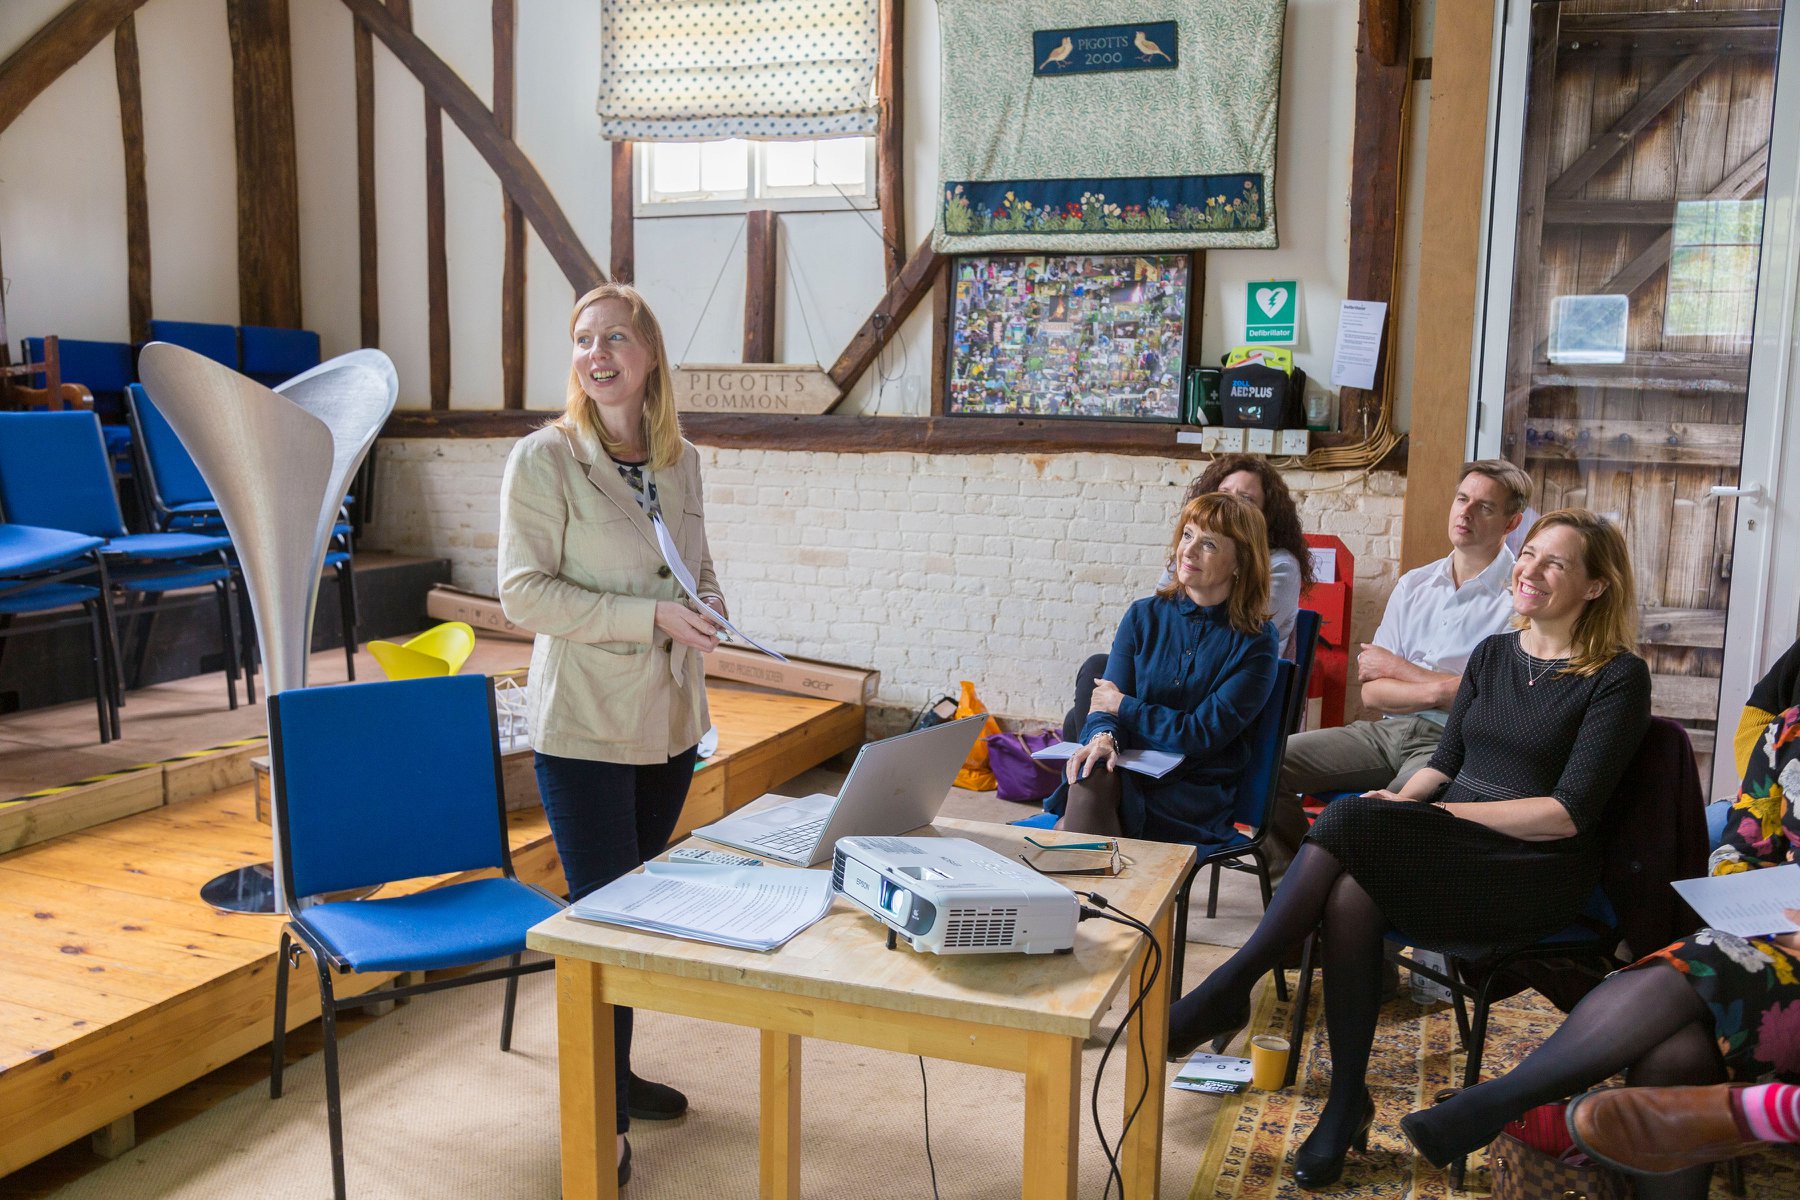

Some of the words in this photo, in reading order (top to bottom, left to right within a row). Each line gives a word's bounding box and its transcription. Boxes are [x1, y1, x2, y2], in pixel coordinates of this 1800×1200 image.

[1078, 35, 1129, 51] PIGOTTS
[1084, 52, 1123, 65] 2000
[1249, 329, 1291, 337] Defibrillator
[690, 373, 805, 392] PIGOTTS
[1231, 379, 1250, 387] ZOLL
[690, 393, 789, 409] COMMON
[802, 677, 834, 691] acer
